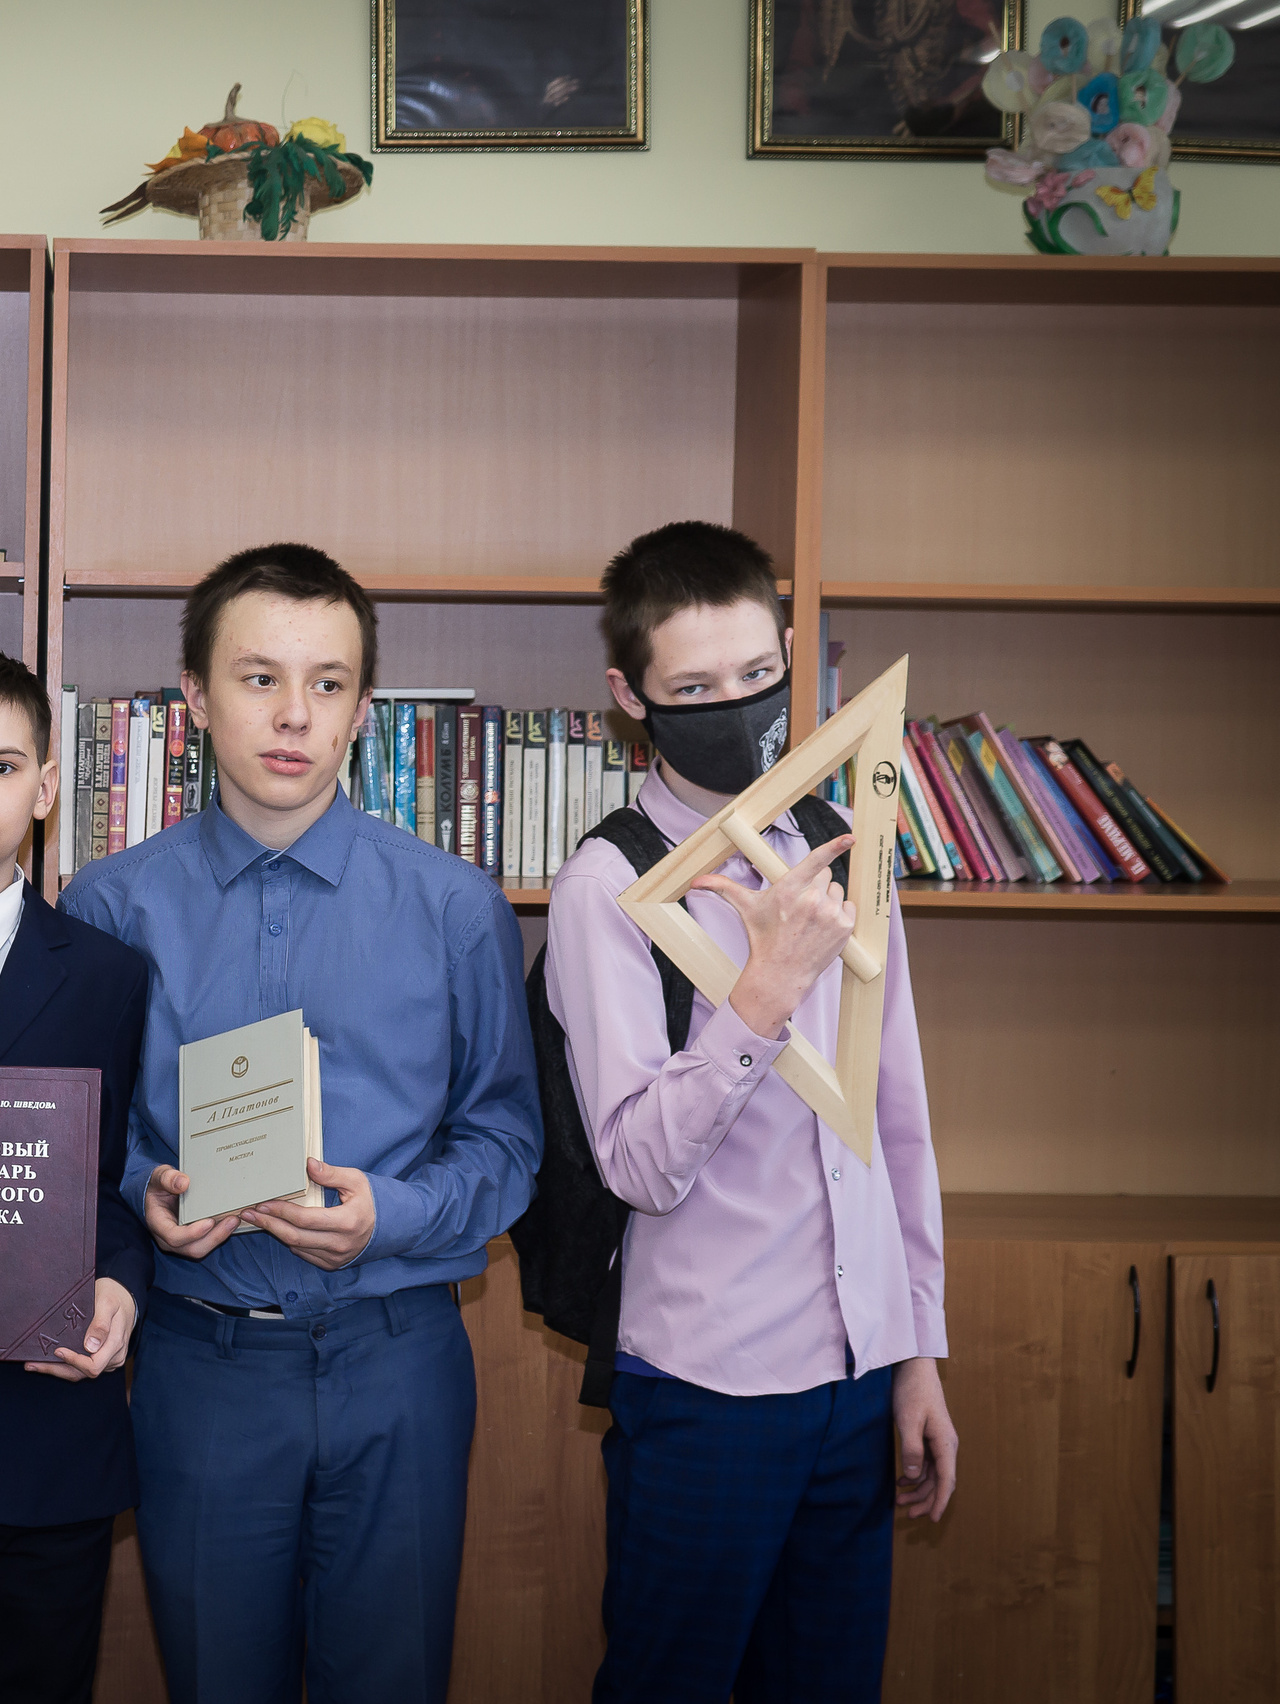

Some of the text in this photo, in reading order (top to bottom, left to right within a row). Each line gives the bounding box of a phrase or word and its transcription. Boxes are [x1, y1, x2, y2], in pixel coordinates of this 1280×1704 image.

[440, 750, 452, 813] КОЛУМБ
[1097, 814, 1136, 861] МЕРИМЕ
[13, 1101, 56, 1110] ШВЕДОВА
[216, 1134, 267, 1153] ПРОИСХОЖДЕНИЕ
[229, 1151, 254, 1162] МАСТЕРА
